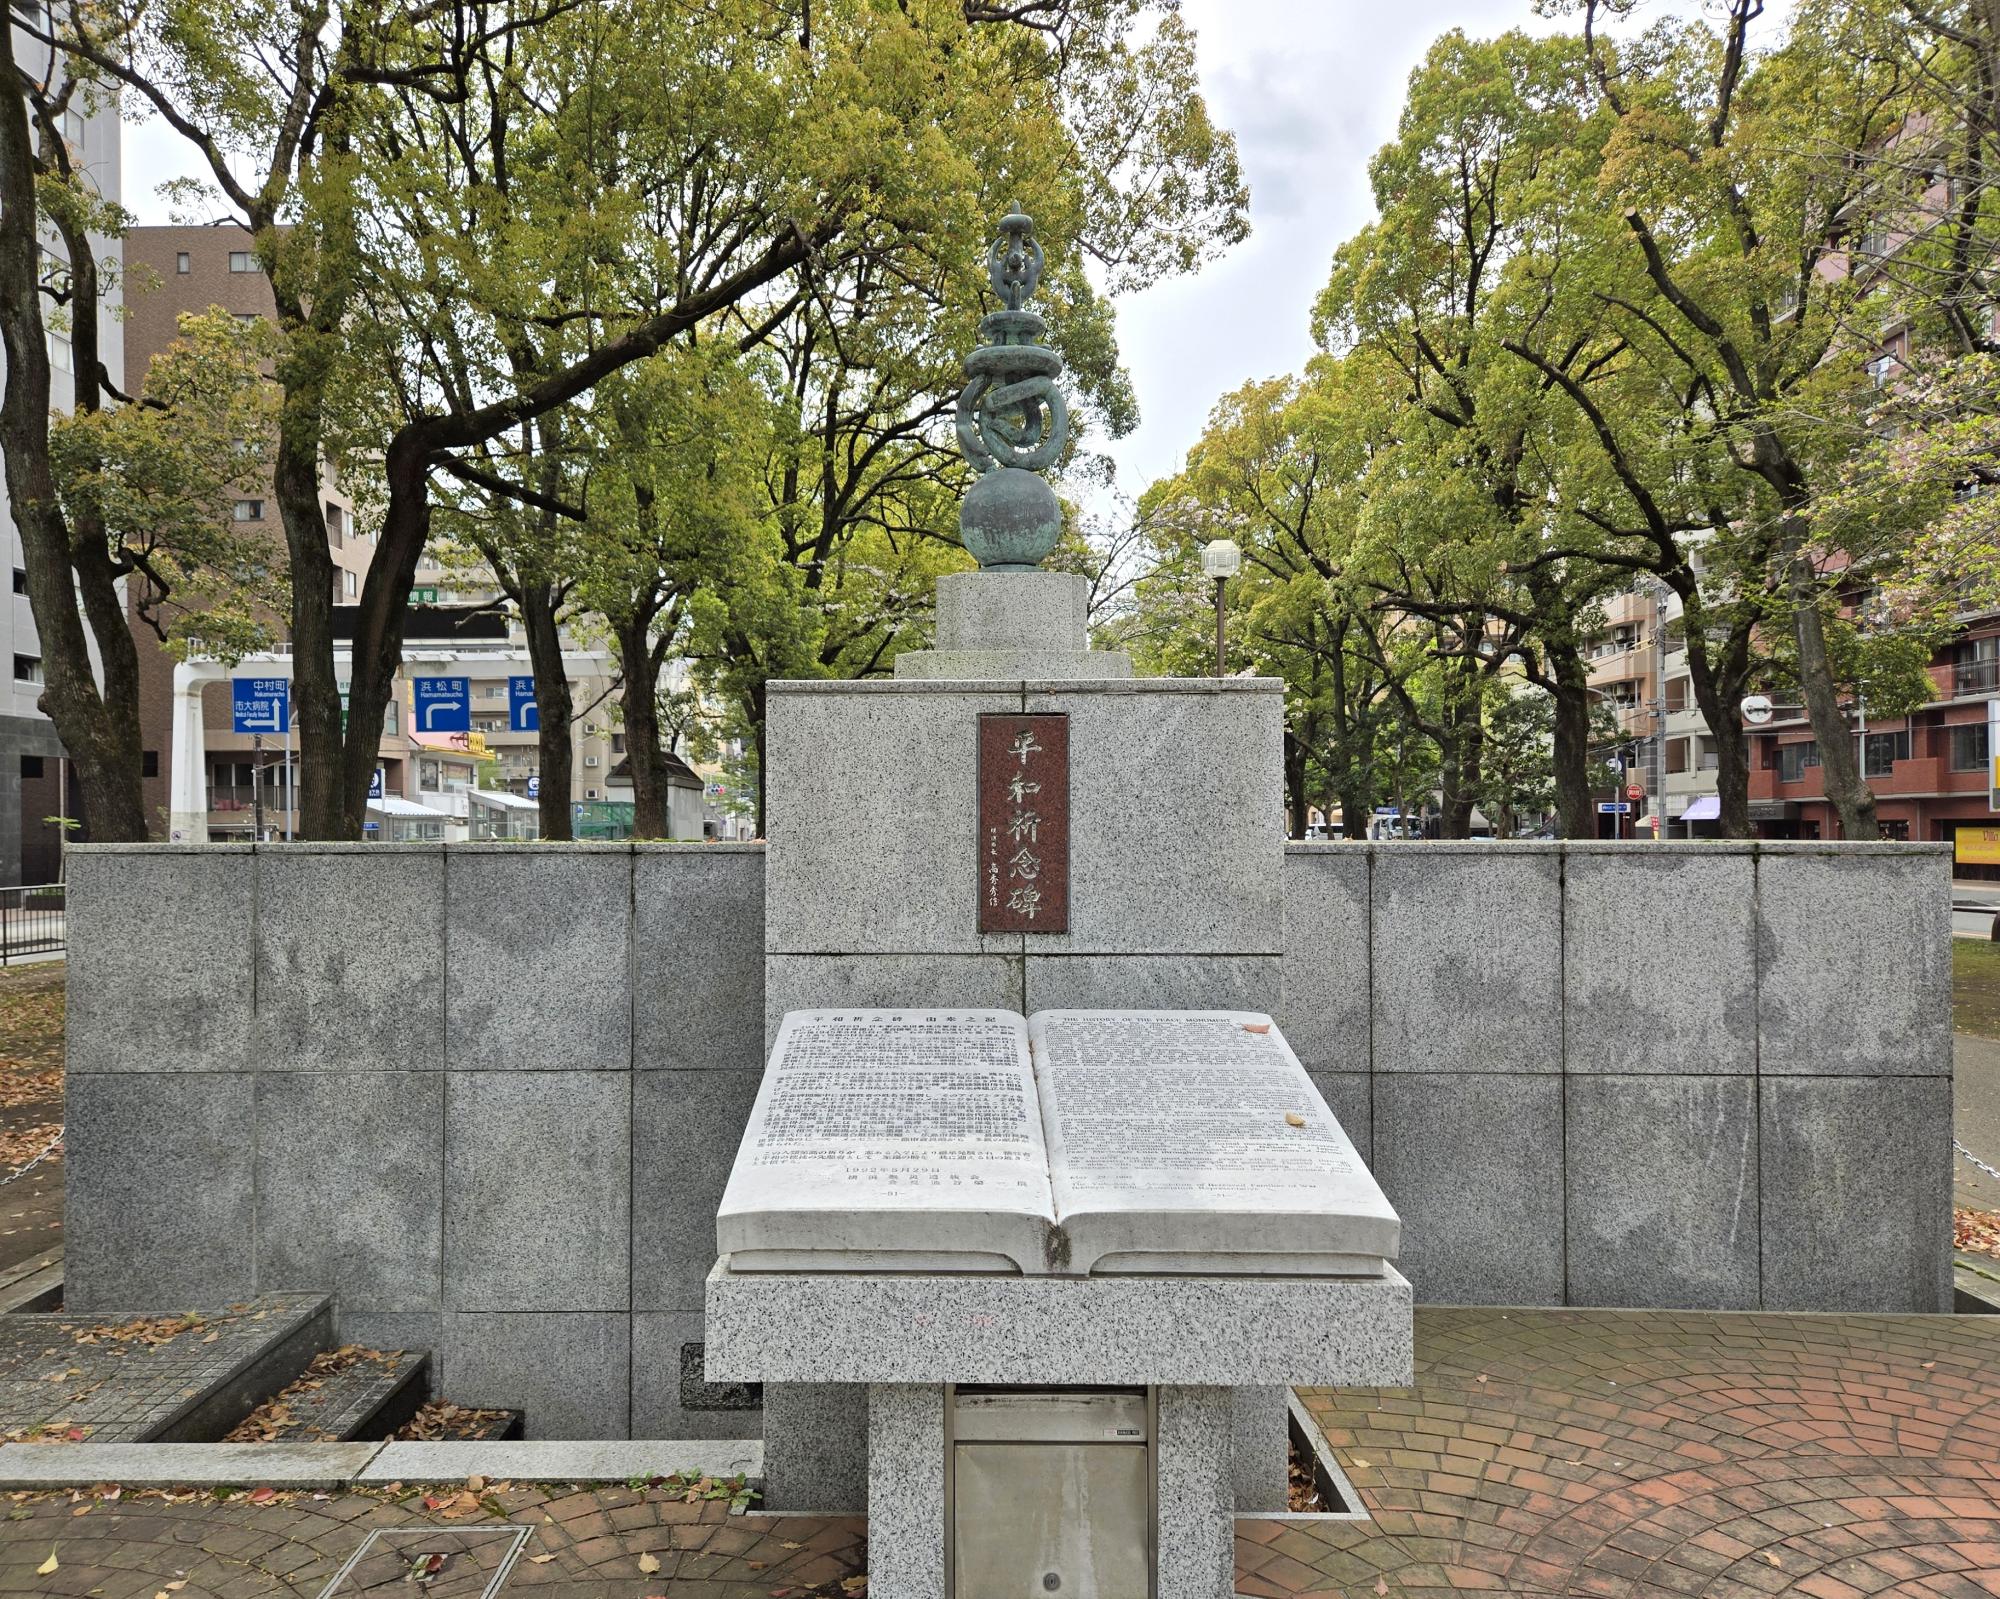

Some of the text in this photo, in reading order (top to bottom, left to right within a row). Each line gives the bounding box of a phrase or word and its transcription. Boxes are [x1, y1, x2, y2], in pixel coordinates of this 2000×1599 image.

[253, 680, 285, 691] 中村町
[420, 680, 462, 691] 浜松町
[235, 701, 270, 712] 市大病院
[1006, 729, 1043, 919] 平和祈念碑
